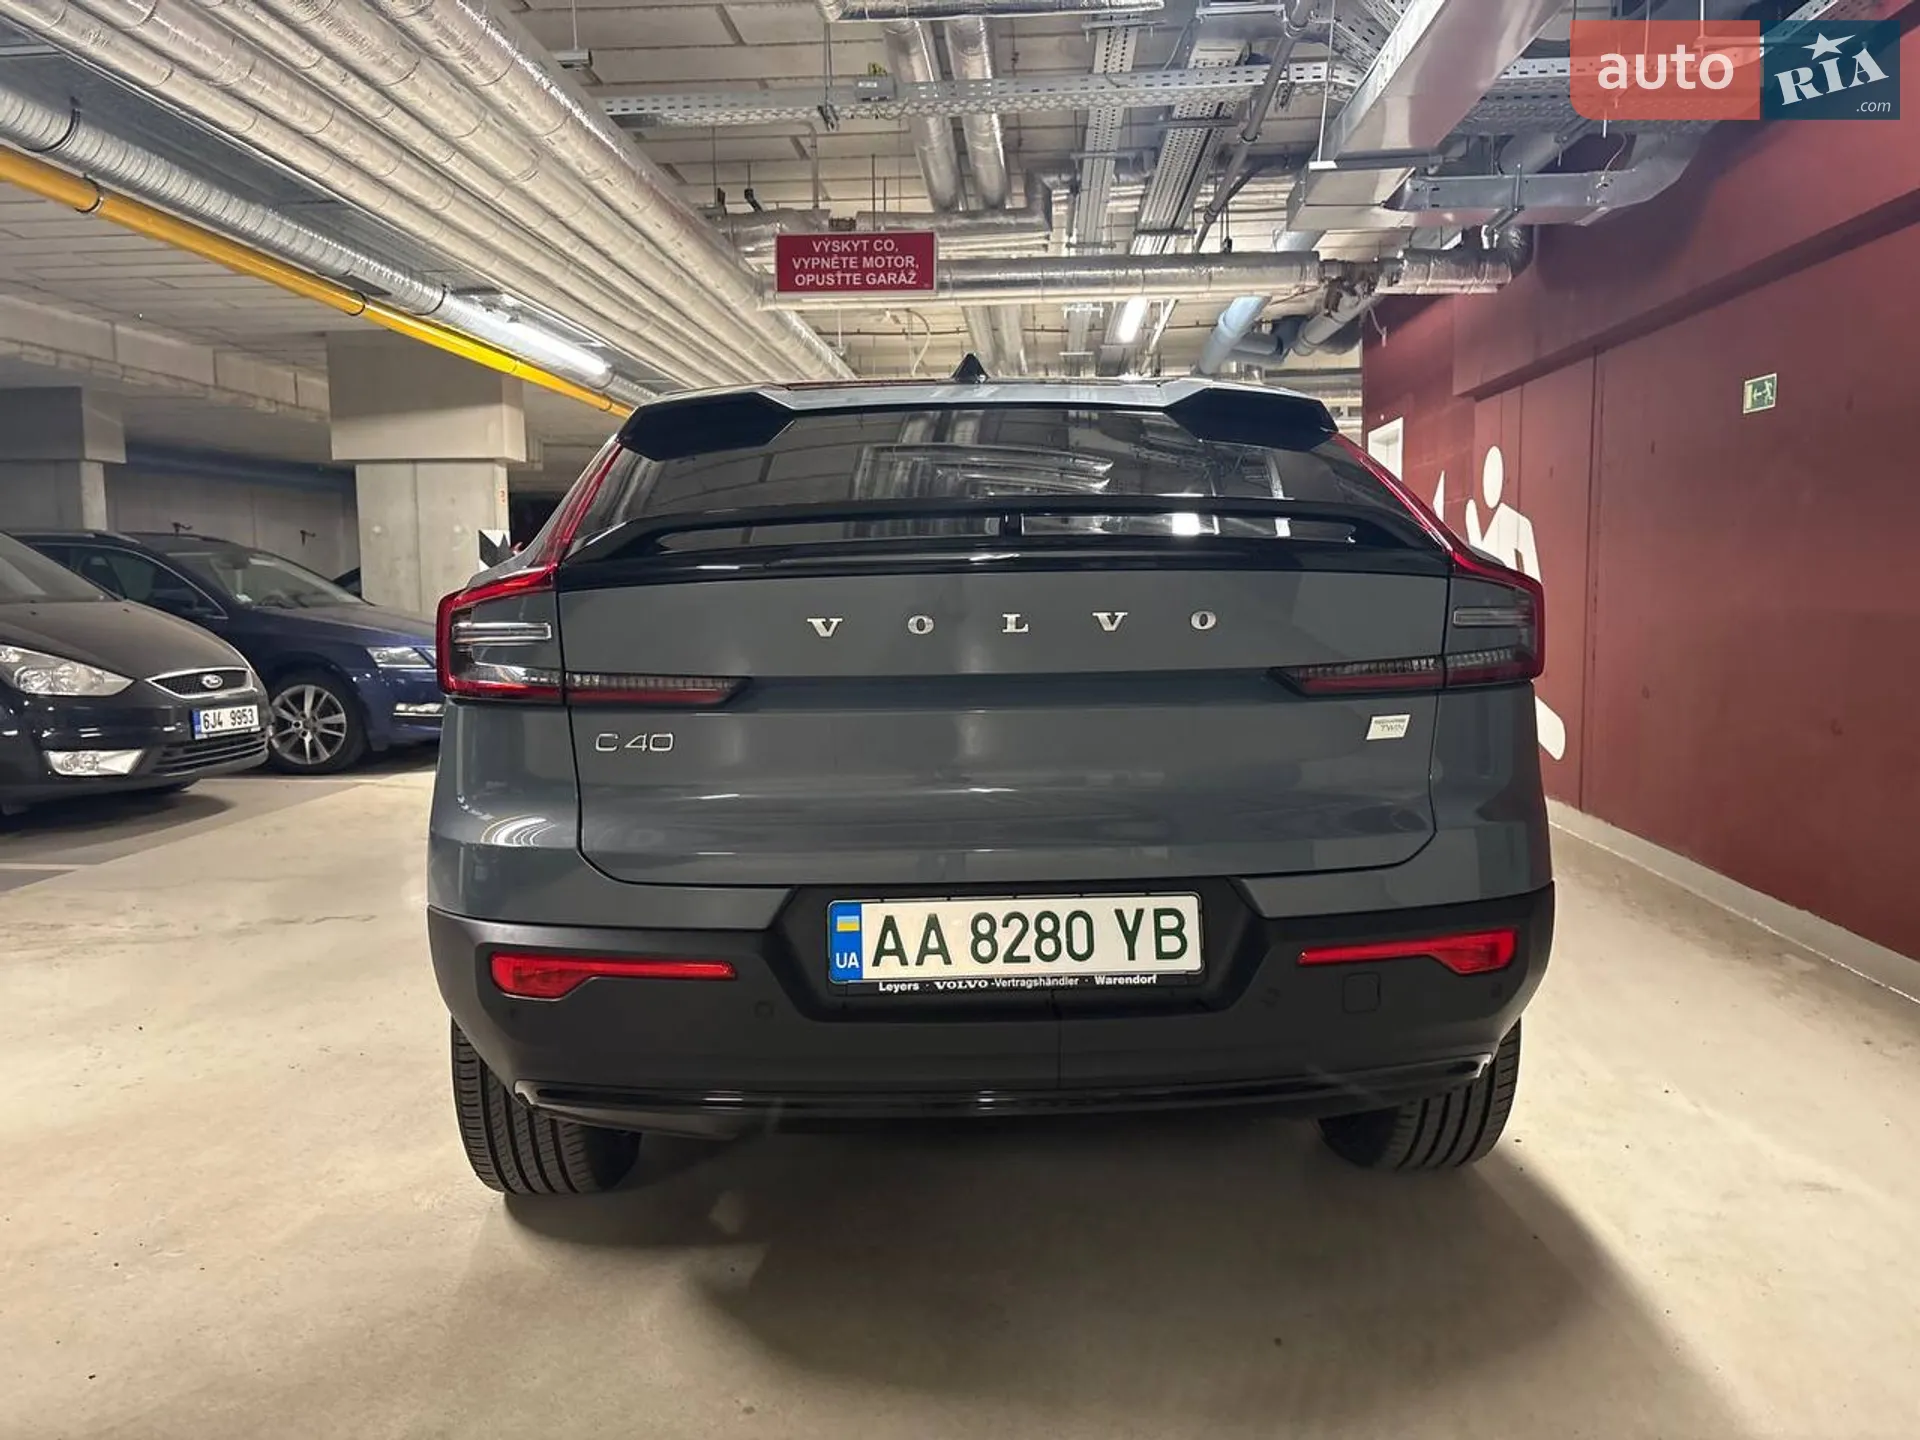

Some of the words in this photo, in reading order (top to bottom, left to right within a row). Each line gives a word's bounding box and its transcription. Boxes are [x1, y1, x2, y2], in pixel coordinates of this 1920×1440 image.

[812, 238, 869, 252] VÝSKYT
[792, 254, 858, 270] VYPNĚTE
[862, 255, 919, 269] MOTOR,
[866, 270, 917, 285] GARÁŽ
[807, 610, 1217, 638] VOLVO
[203, 711, 223, 730] 6J4
[230, 708, 254, 726] 9953
[872, 913, 952, 967] AA
[970, 910, 1095, 964] 8280
[1114, 907, 1188, 961] YB
[836, 952, 860, 969] UA
[878, 981, 920, 993] Leyers
[934, 980, 988, 990] VOLVO
[1094, 974, 1157, 986] Warendorf
